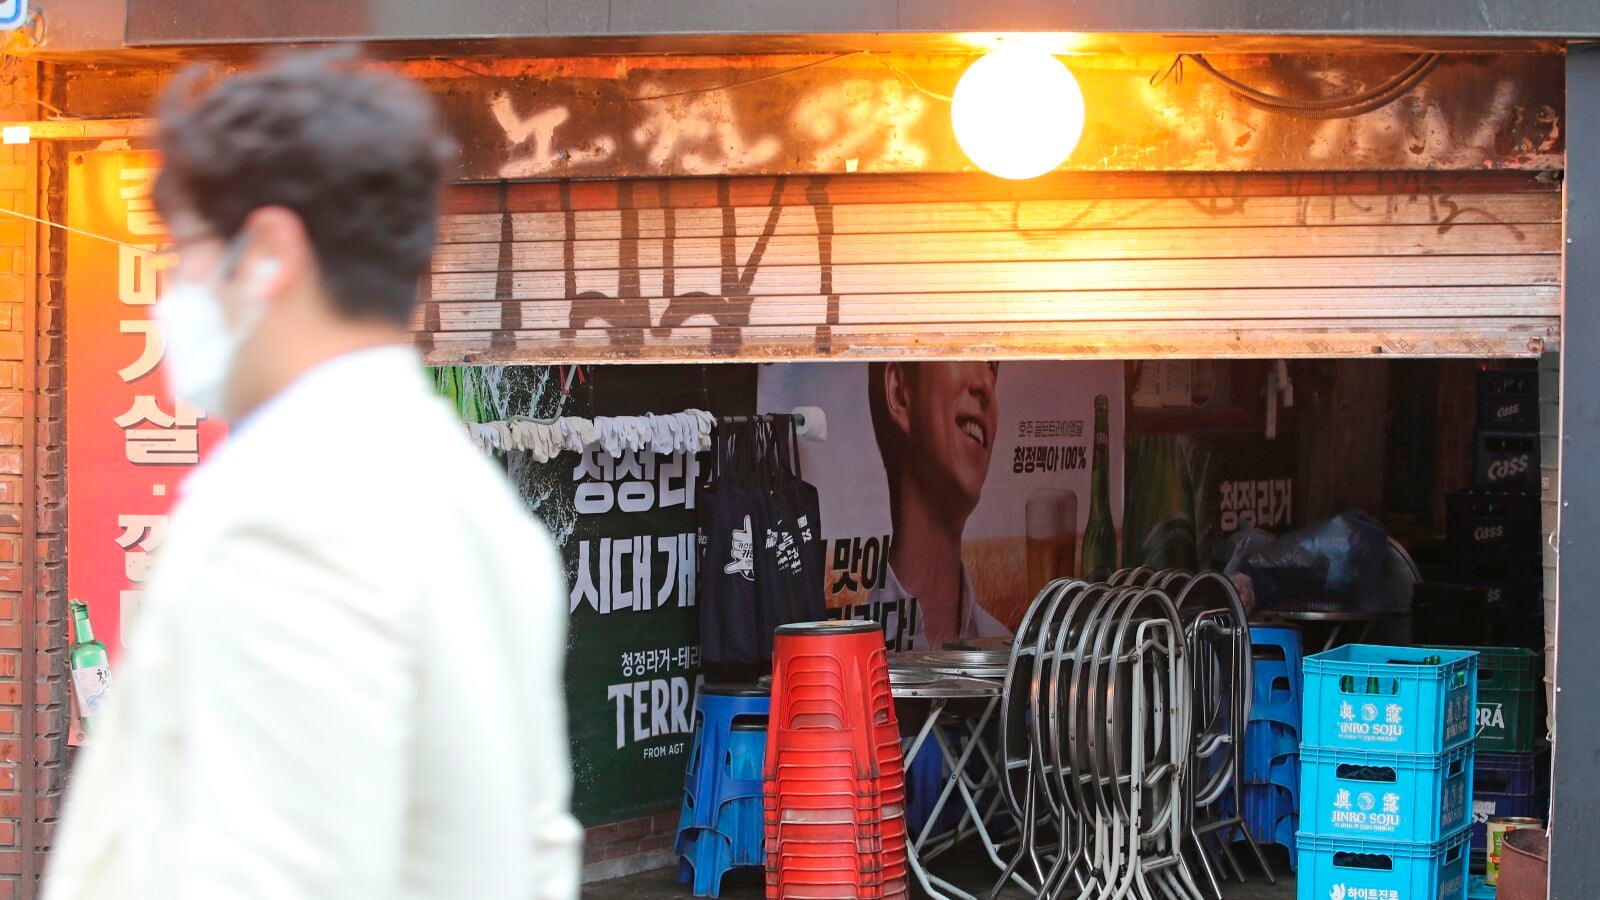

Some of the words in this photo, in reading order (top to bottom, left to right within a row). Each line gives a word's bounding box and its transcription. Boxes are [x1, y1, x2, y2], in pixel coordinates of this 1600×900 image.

[1497, 404, 1519, 417] Cass
[1018, 420, 1033, 438] 호주
[1013, 446, 1059, 473] 청정맥아
[1061, 446, 1086, 470] 100%
[1487, 455, 1528, 481] Cass
[1220, 478, 1292, 531] 청정라거
[1474, 525, 1504, 541] Cass
[657, 533, 696, 607] 개
[832, 535, 890, 594] 맛이
[1338, 722, 1369, 734] INRO
[1373, 724, 1402, 736] SOJU
[643, 745, 666, 759] FROM
[669, 743, 685, 755] AGT
[1332, 811, 1366, 823] JINRO
[1369, 813, 1400, 826] SOJU
[1347, 887, 1399, 900] 하이트진로
